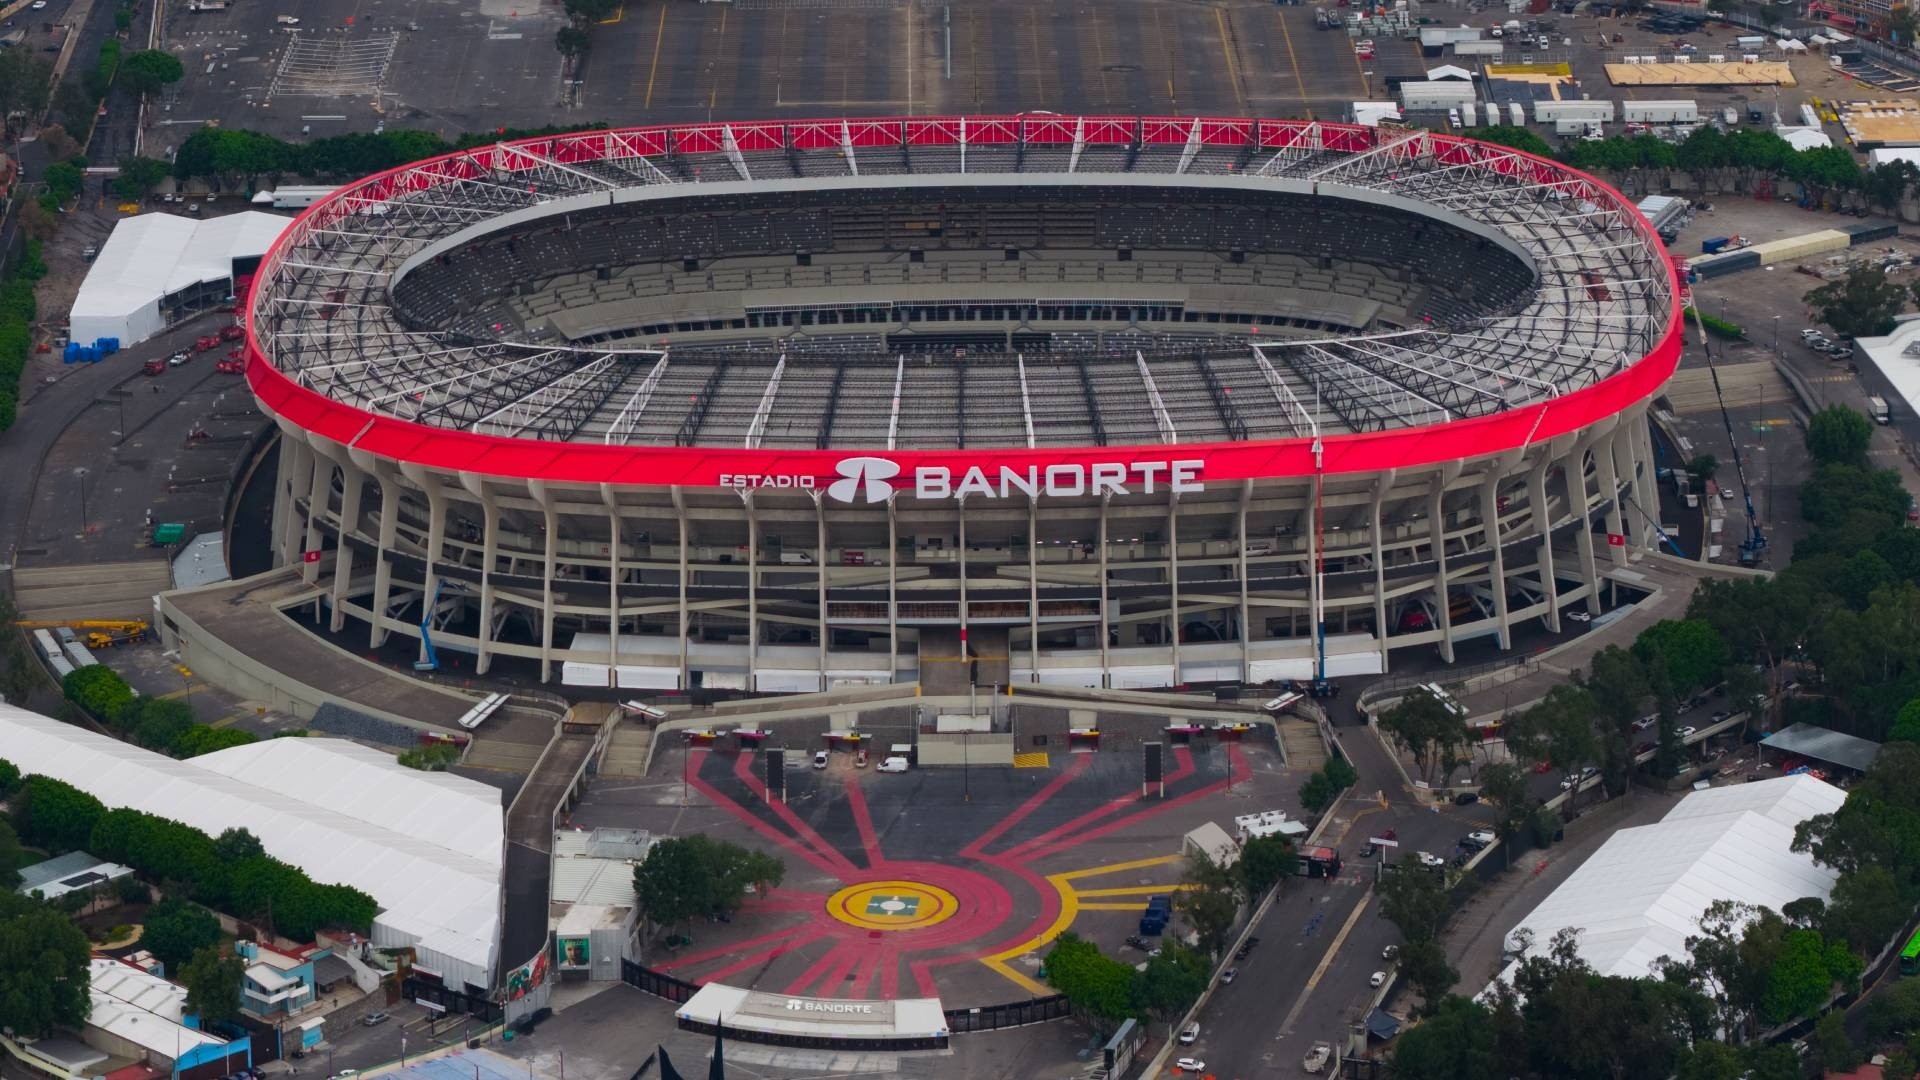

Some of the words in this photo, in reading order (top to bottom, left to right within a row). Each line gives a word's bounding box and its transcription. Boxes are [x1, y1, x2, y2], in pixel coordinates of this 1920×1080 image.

[719, 474, 815, 488] ESTADIO
[915, 460, 1205, 499] BANORTE
[805, 1003, 872, 1013] BANORTE
